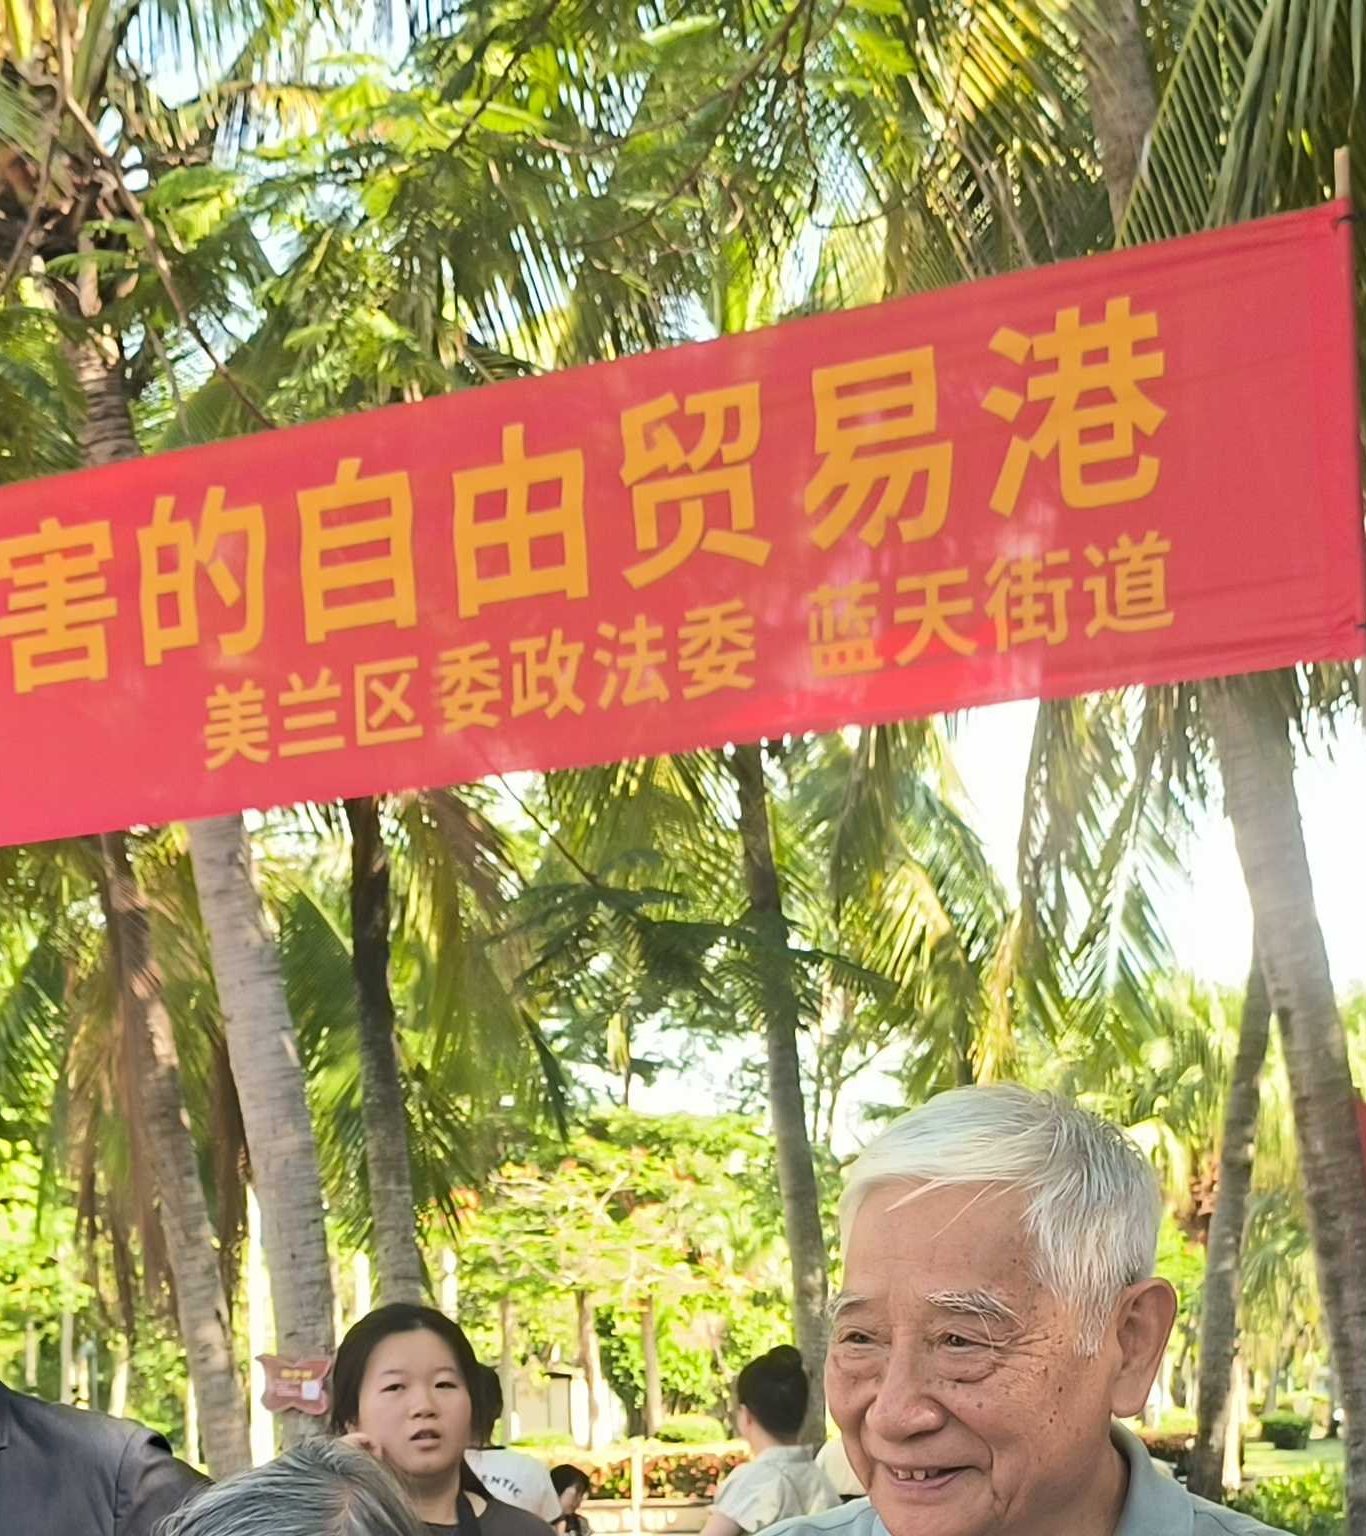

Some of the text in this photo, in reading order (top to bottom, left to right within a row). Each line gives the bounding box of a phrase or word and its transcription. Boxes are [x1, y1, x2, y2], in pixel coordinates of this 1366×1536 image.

[202, 532, 1175, 770] 美兰区委政法委 蓝天街道
